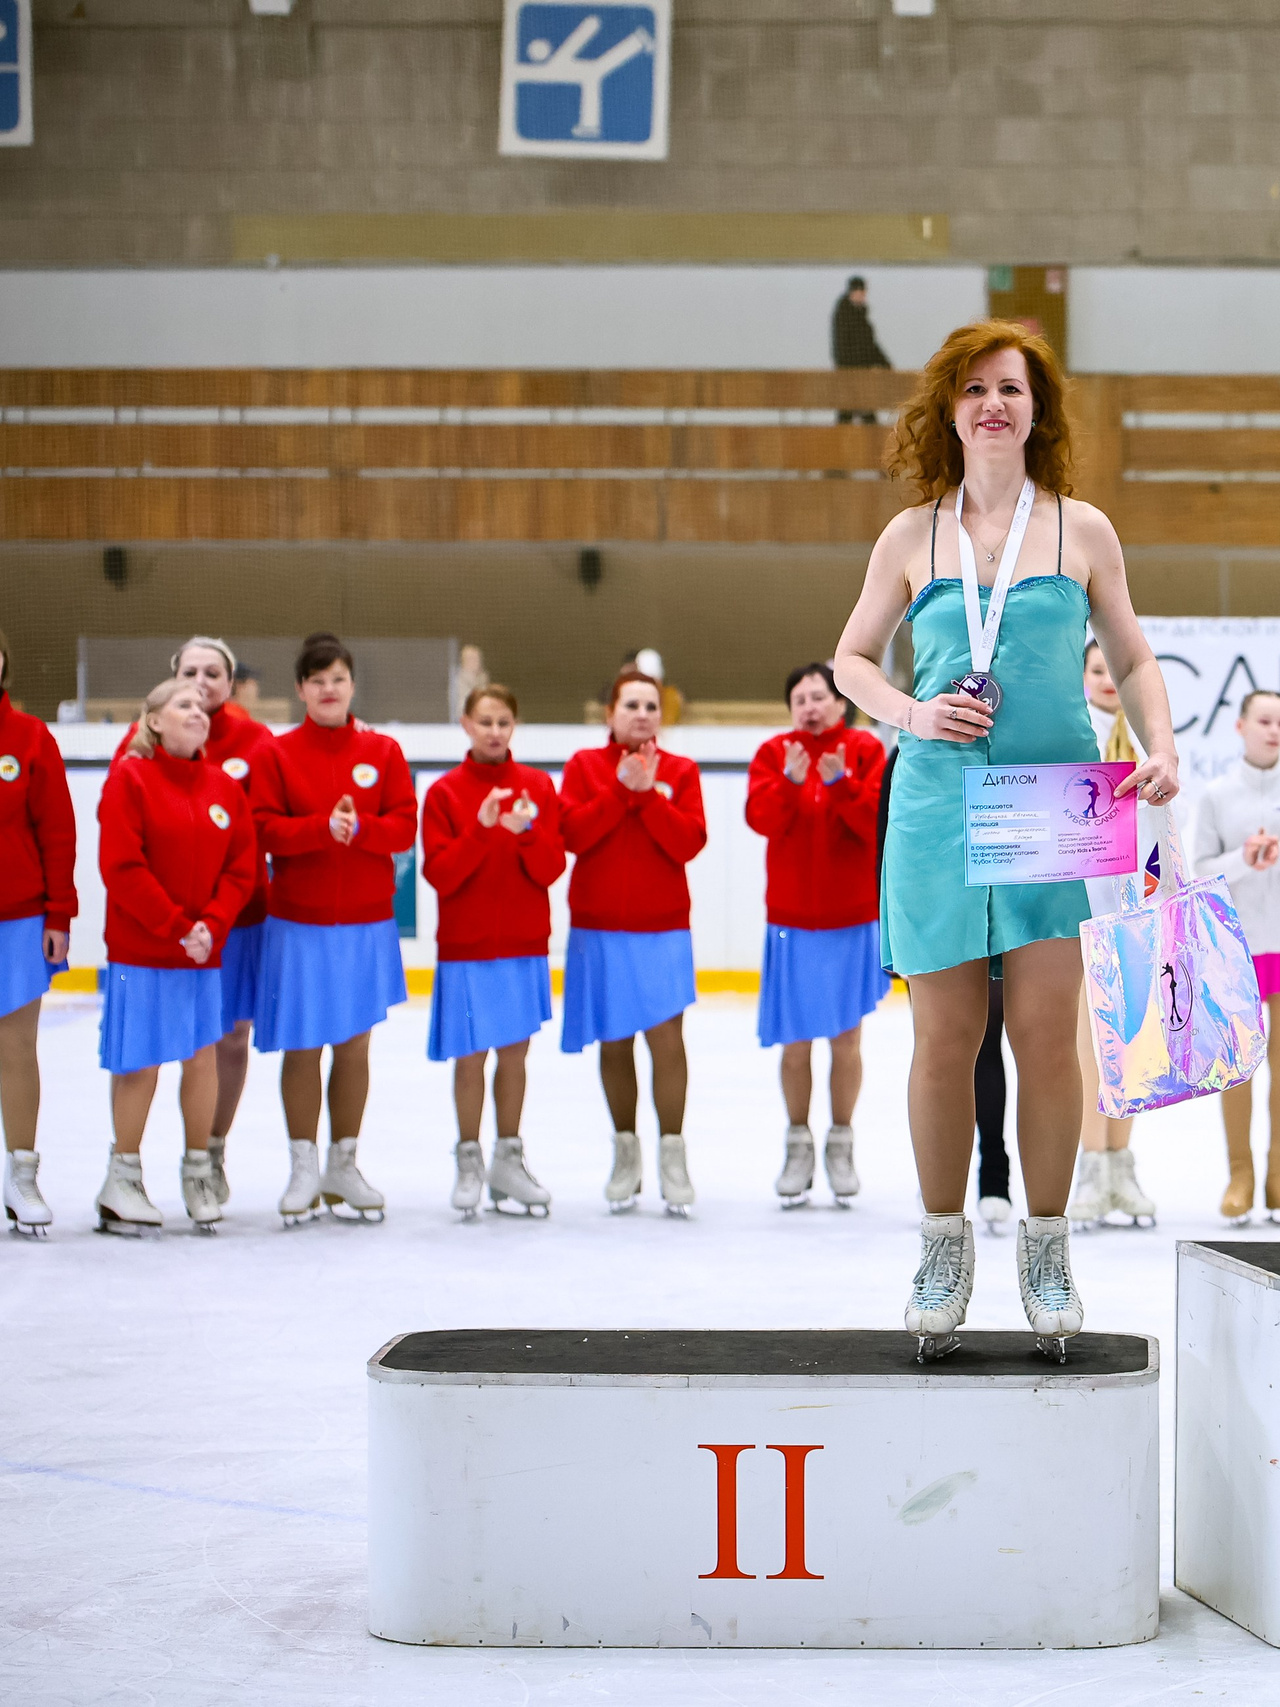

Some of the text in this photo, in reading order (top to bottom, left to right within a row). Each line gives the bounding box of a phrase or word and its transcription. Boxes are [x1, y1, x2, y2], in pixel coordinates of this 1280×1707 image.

[1063, 806, 1120, 827] КУБОК CANDY
[697, 1444, 825, 1580] II
